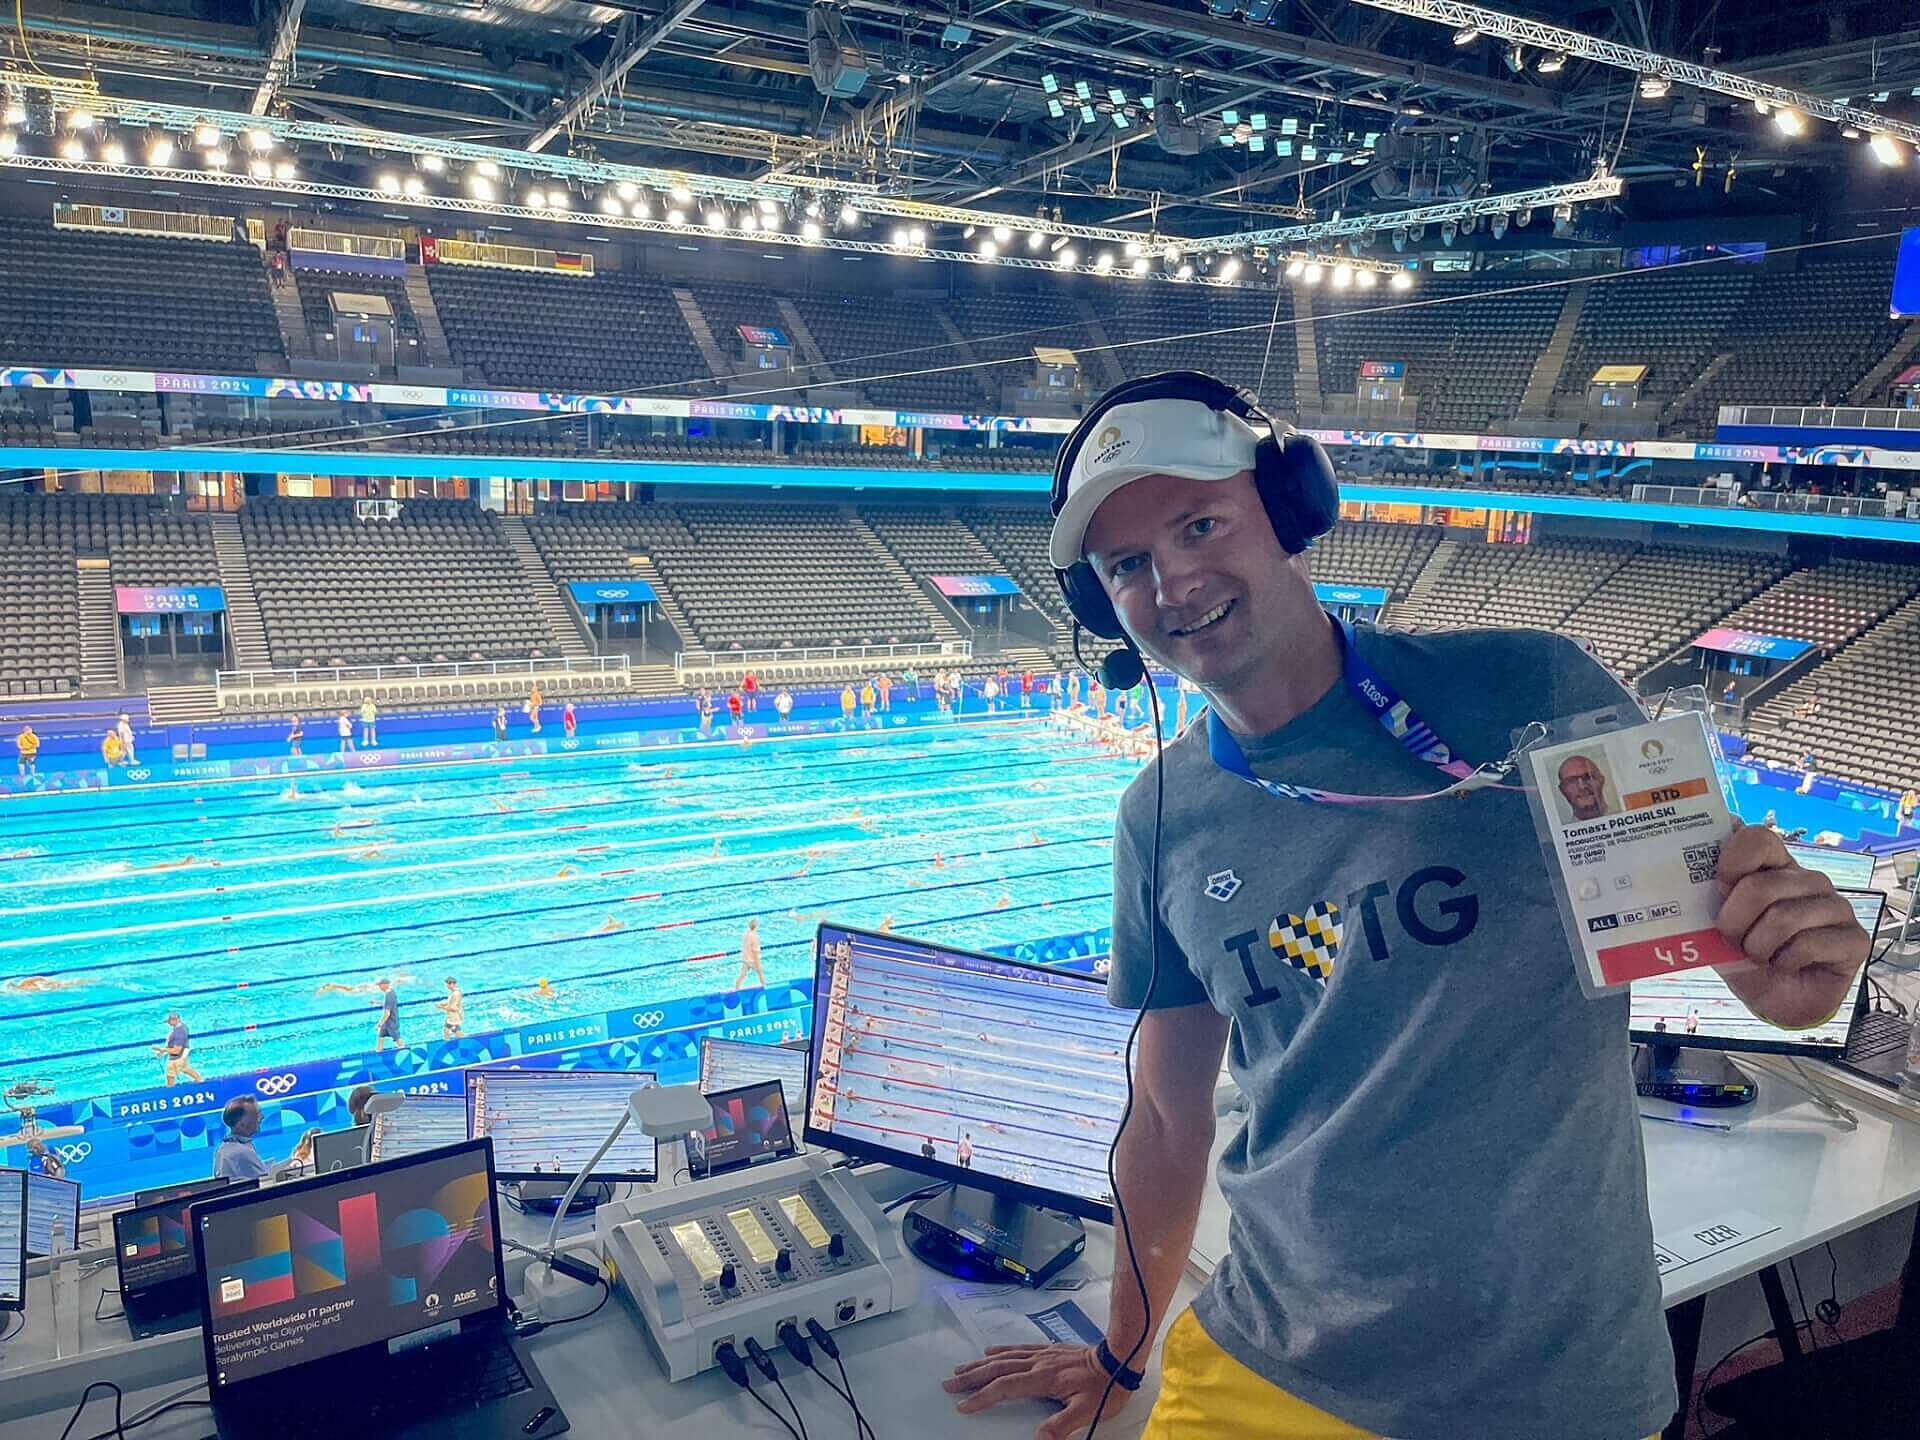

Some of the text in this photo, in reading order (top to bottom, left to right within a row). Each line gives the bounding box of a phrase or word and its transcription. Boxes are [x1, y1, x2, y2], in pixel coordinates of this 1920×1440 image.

[163, 378, 250, 392] PARIS 2024
[452, 393, 526, 405] PARIS 2024
[1700, 447, 1732, 457] PARIS
[1358, 678, 1389, 708] Atos
[1562, 806, 1676, 839] Tomasz PACHALSKI
[1592, 905, 1678, 930] ALL IBC MPC
[1224, 865, 1480, 1007] I TG
[528, 1024, 602, 1045] PARIS 2024
[729, 1018, 796, 1039] PARIS 2024
[410, 1081, 448, 1096] 2024
[121, 1091, 215, 1116] PARIS 2024
[1694, 1224, 1741, 1246] CZER
[454, 1289, 477, 1303] Atos
[213, 1299, 355, 1344] Trusted Worldwide IT partner
[216, 1313, 340, 1354] delivering the Olympic and
[216, 1336, 304, 1366] Paralympic Games
